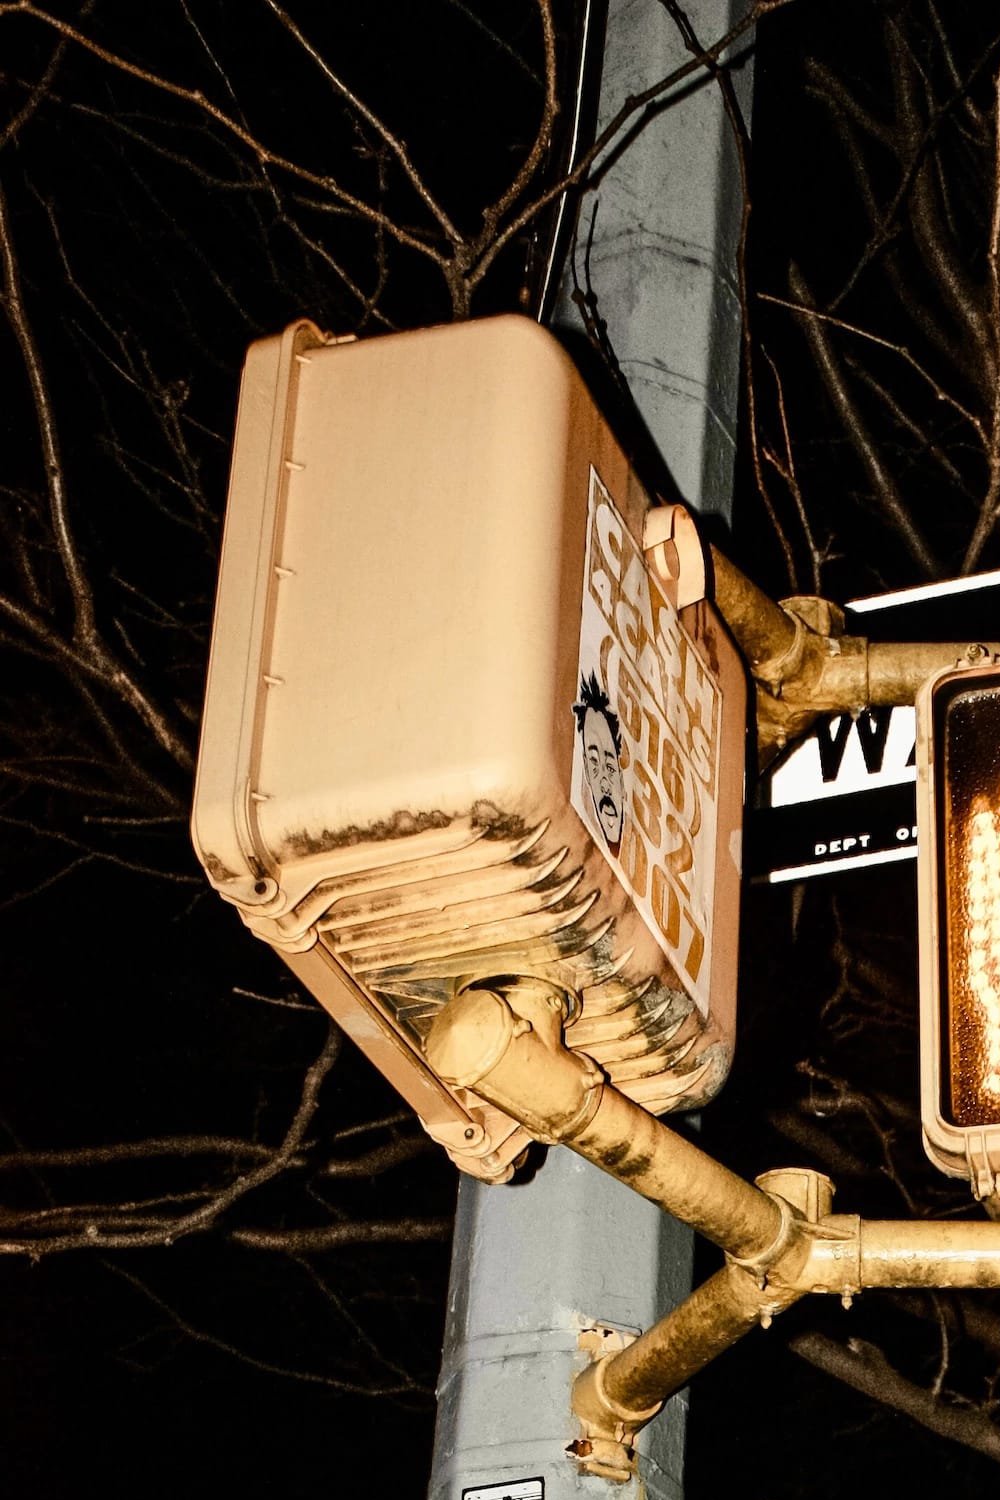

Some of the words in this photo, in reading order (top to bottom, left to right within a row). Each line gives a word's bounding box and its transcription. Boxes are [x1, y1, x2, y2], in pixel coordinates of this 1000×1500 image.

[600, 635, 702, 837] (516)
[616, 600, 711, 782] CARS
[814, 704, 916, 783] W
[583, 775, 704, 983] 007
[814, 835, 871, 855] DEPT
